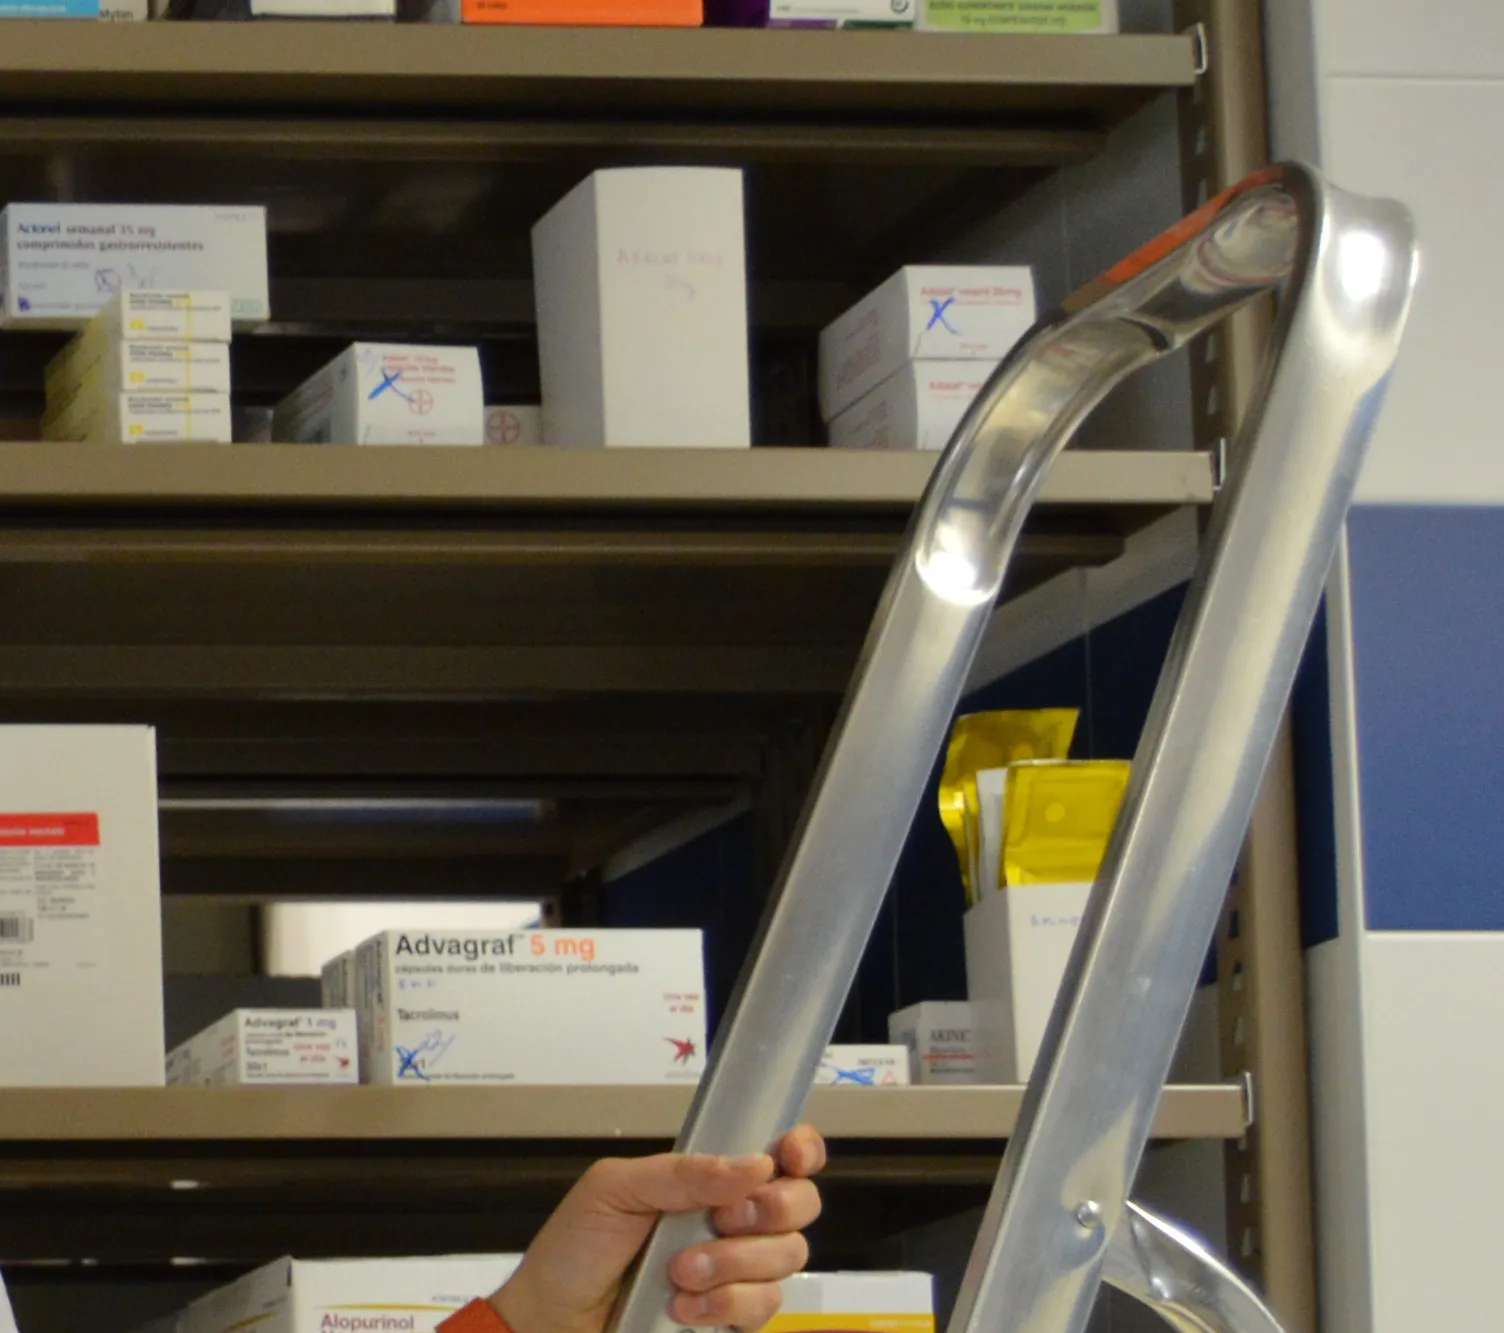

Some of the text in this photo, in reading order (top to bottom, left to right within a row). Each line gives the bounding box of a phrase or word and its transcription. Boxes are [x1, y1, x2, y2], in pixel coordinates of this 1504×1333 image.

[530, 934, 597, 962] 5 mg
[498, 961, 564, 975] liberación
[566, 962, 640, 978] prolongada
[320, 1311, 415, 1333] Alopurinol
